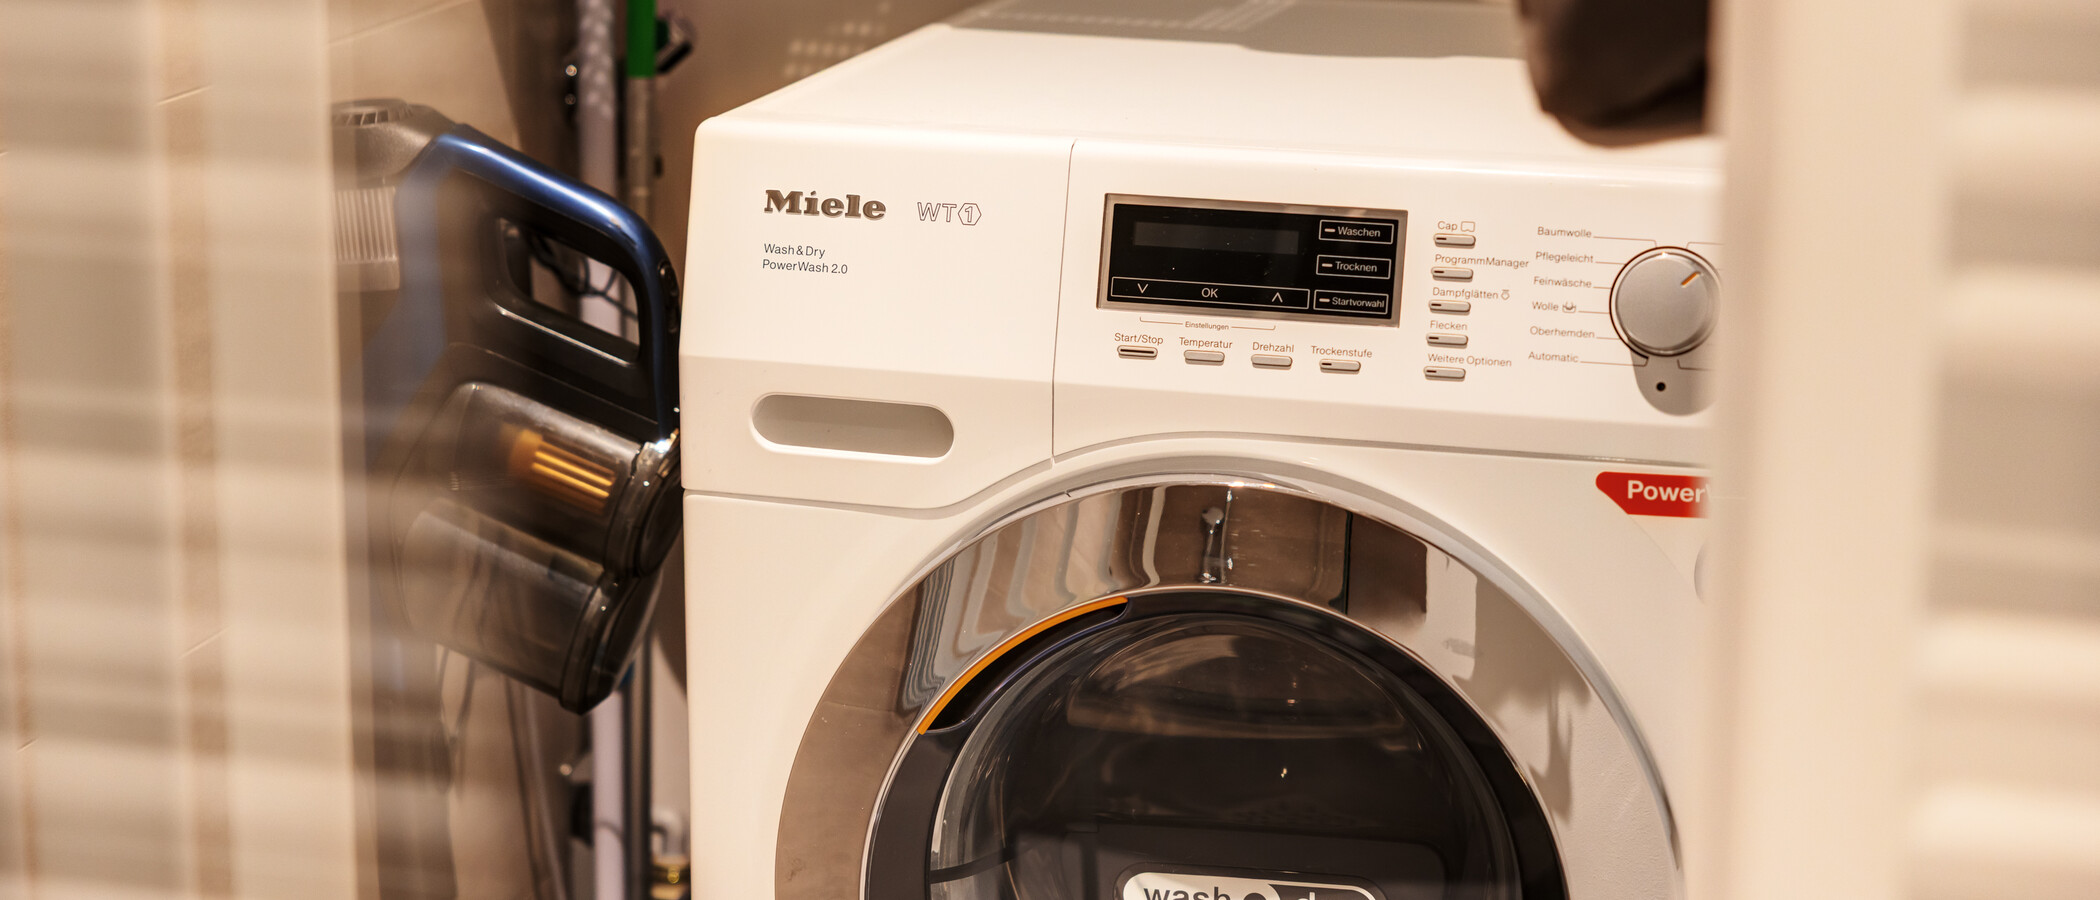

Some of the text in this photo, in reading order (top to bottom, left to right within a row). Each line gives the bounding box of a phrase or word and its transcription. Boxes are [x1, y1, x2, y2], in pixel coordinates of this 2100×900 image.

[764, 189, 887, 220] Miele
[1437, 220, 1458, 231] Cap
[1337, 226, 1381, 238] Waschen
[1537, 226, 1592, 238] Baumwolle
[1434, 254, 1529, 269] ProgrammManager
[1535, 251, 1594, 264] Pflegeleicht
[762, 259, 848, 274] PowerWash 2.0
[1335, 261, 1378, 273] Trocknen
[1533, 276, 1592, 288] Feinwäsche
[1201, 287, 1218, 299] OK
[1432, 287, 1499, 300] Dampfglätten
[1332, 297, 1385, 308] Startvorwahl
[1532, 302, 1559, 312] Wolle
[1185, 321, 1229, 331] Einstellungen
[1430, 320, 1468, 331] Flecken
[1529, 325, 1595, 339] Oberhemden
[1114, 332, 1164, 345] Start/Stop
[1179, 337, 1233, 350] Temperatur
[1252, 342, 1295, 353] Drehzahl
[1311, 345, 1373, 359] Trockenstufe
[1428, 354, 1512, 367] Weitere Optionen
[1528, 352, 1579, 363] Automatic
[1627, 480, 1711, 503] Power
